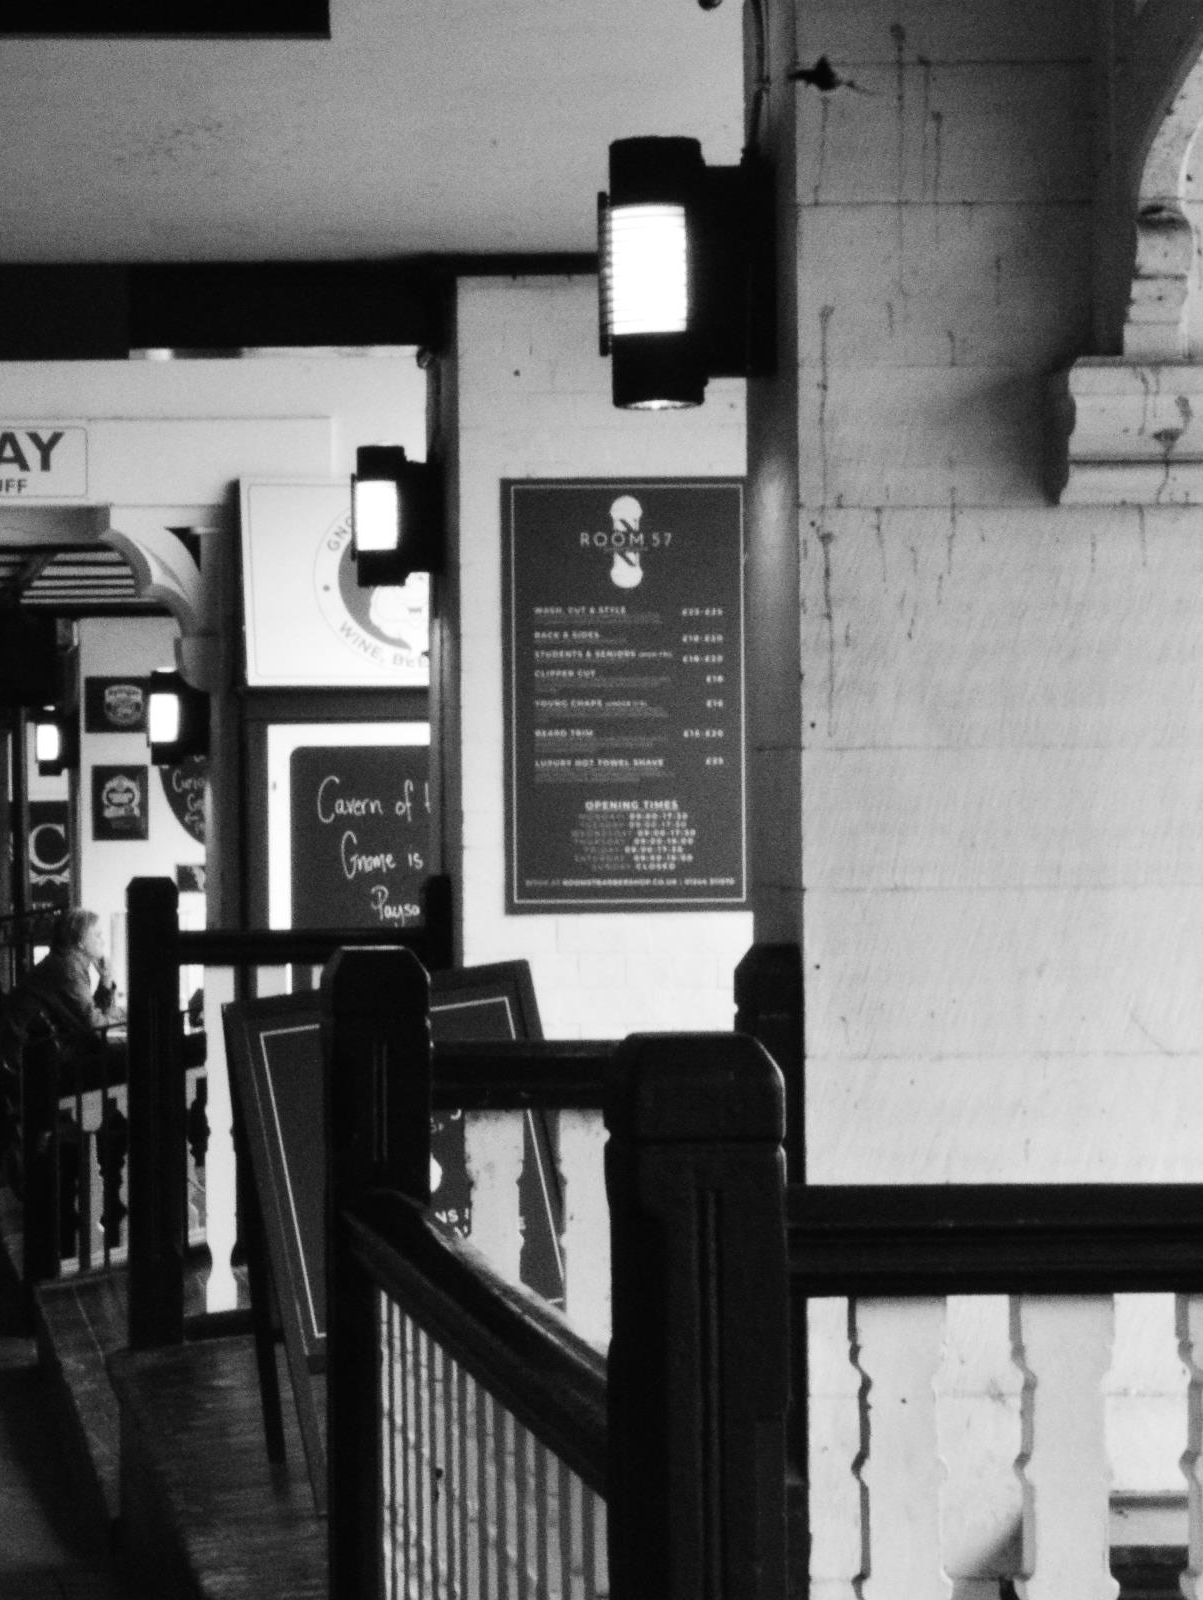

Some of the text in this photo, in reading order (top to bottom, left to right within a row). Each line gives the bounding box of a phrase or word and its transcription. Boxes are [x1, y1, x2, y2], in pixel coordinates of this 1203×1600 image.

[580, 530, 673, 547] ROOM 57
[534, 649, 584, 659] STUDENTS
[316, 775, 385, 824] Cavern
[395, 779, 415, 822] of
[585, 799, 679, 811] OPENING TIMES
[340, 829, 425, 879] Gnome is
